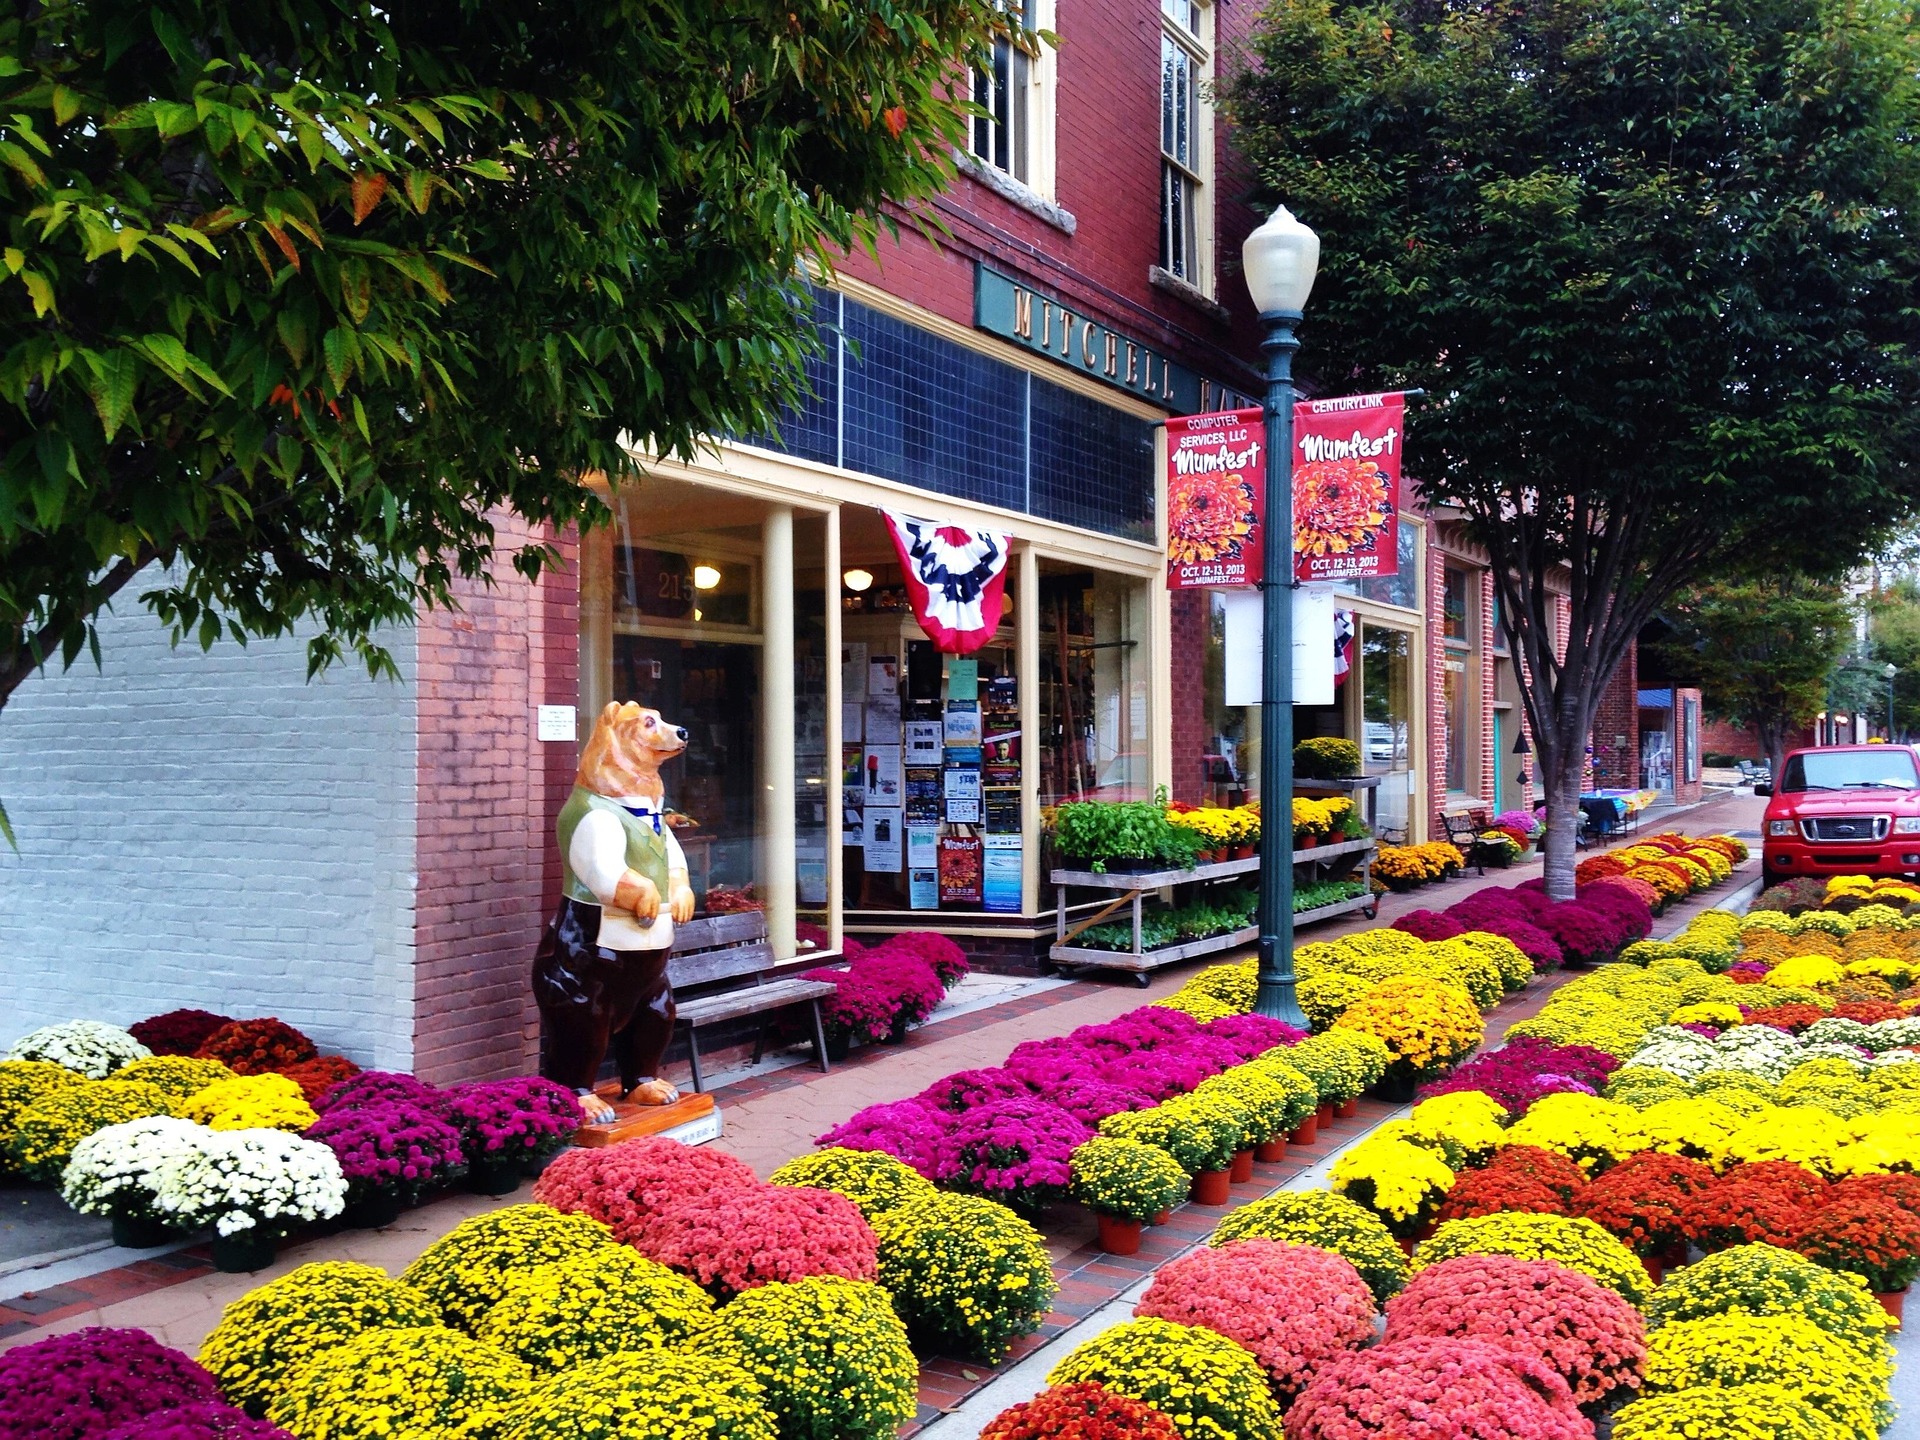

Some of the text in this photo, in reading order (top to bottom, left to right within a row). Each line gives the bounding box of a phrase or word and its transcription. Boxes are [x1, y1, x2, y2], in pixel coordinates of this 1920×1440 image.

[1014, 286, 1174, 400] MITCHELL
[1312, 395, 1384, 414] CENTURYLINK
[1187, 415, 1239, 431] COMPUTER
[1180, 429, 1248, 449] SERVICES, LLC
[1299, 427, 1398, 463] Mumfest
[1172, 441, 1261, 475] Mumfest
[1181, 564, 1246, 578] OCT. 12-13, 2013
[1311, 556, 1379, 570] OCT. 12-13, 2013
[659, 572, 694, 601] 215
